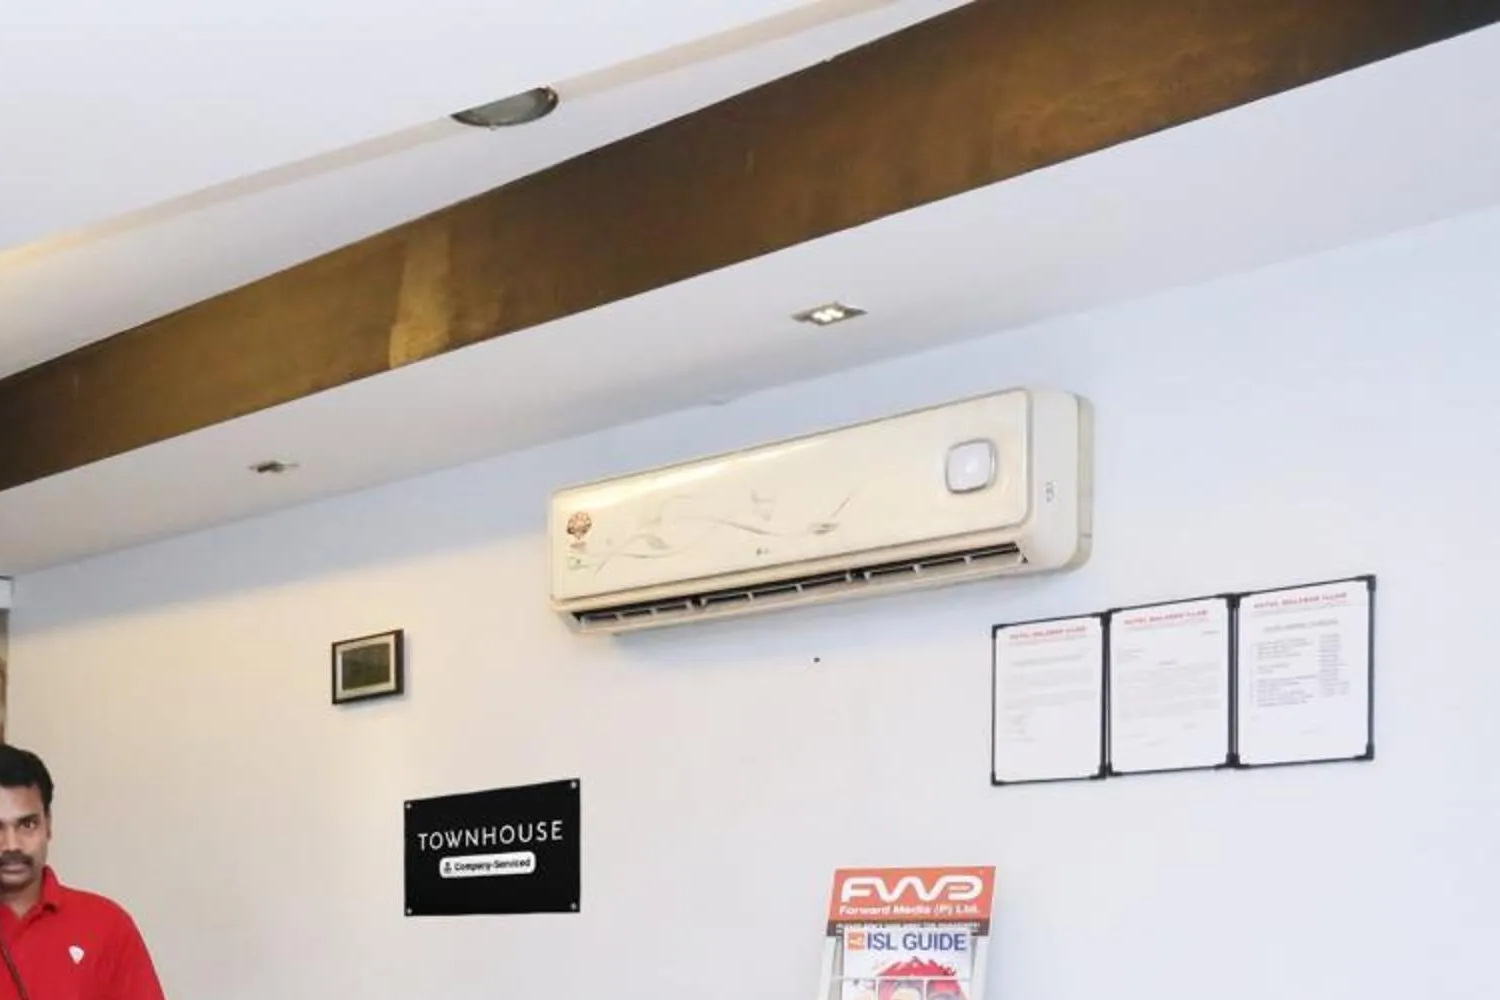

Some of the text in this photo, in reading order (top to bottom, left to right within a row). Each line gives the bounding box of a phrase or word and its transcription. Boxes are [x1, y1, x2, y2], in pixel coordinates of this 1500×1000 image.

[417, 820, 563, 851] TOWNHOUSE
[839, 904, 891, 916] Forward
[893, 904, 932, 916] Media
[867, 931, 967, 951] ISL GUIDE
